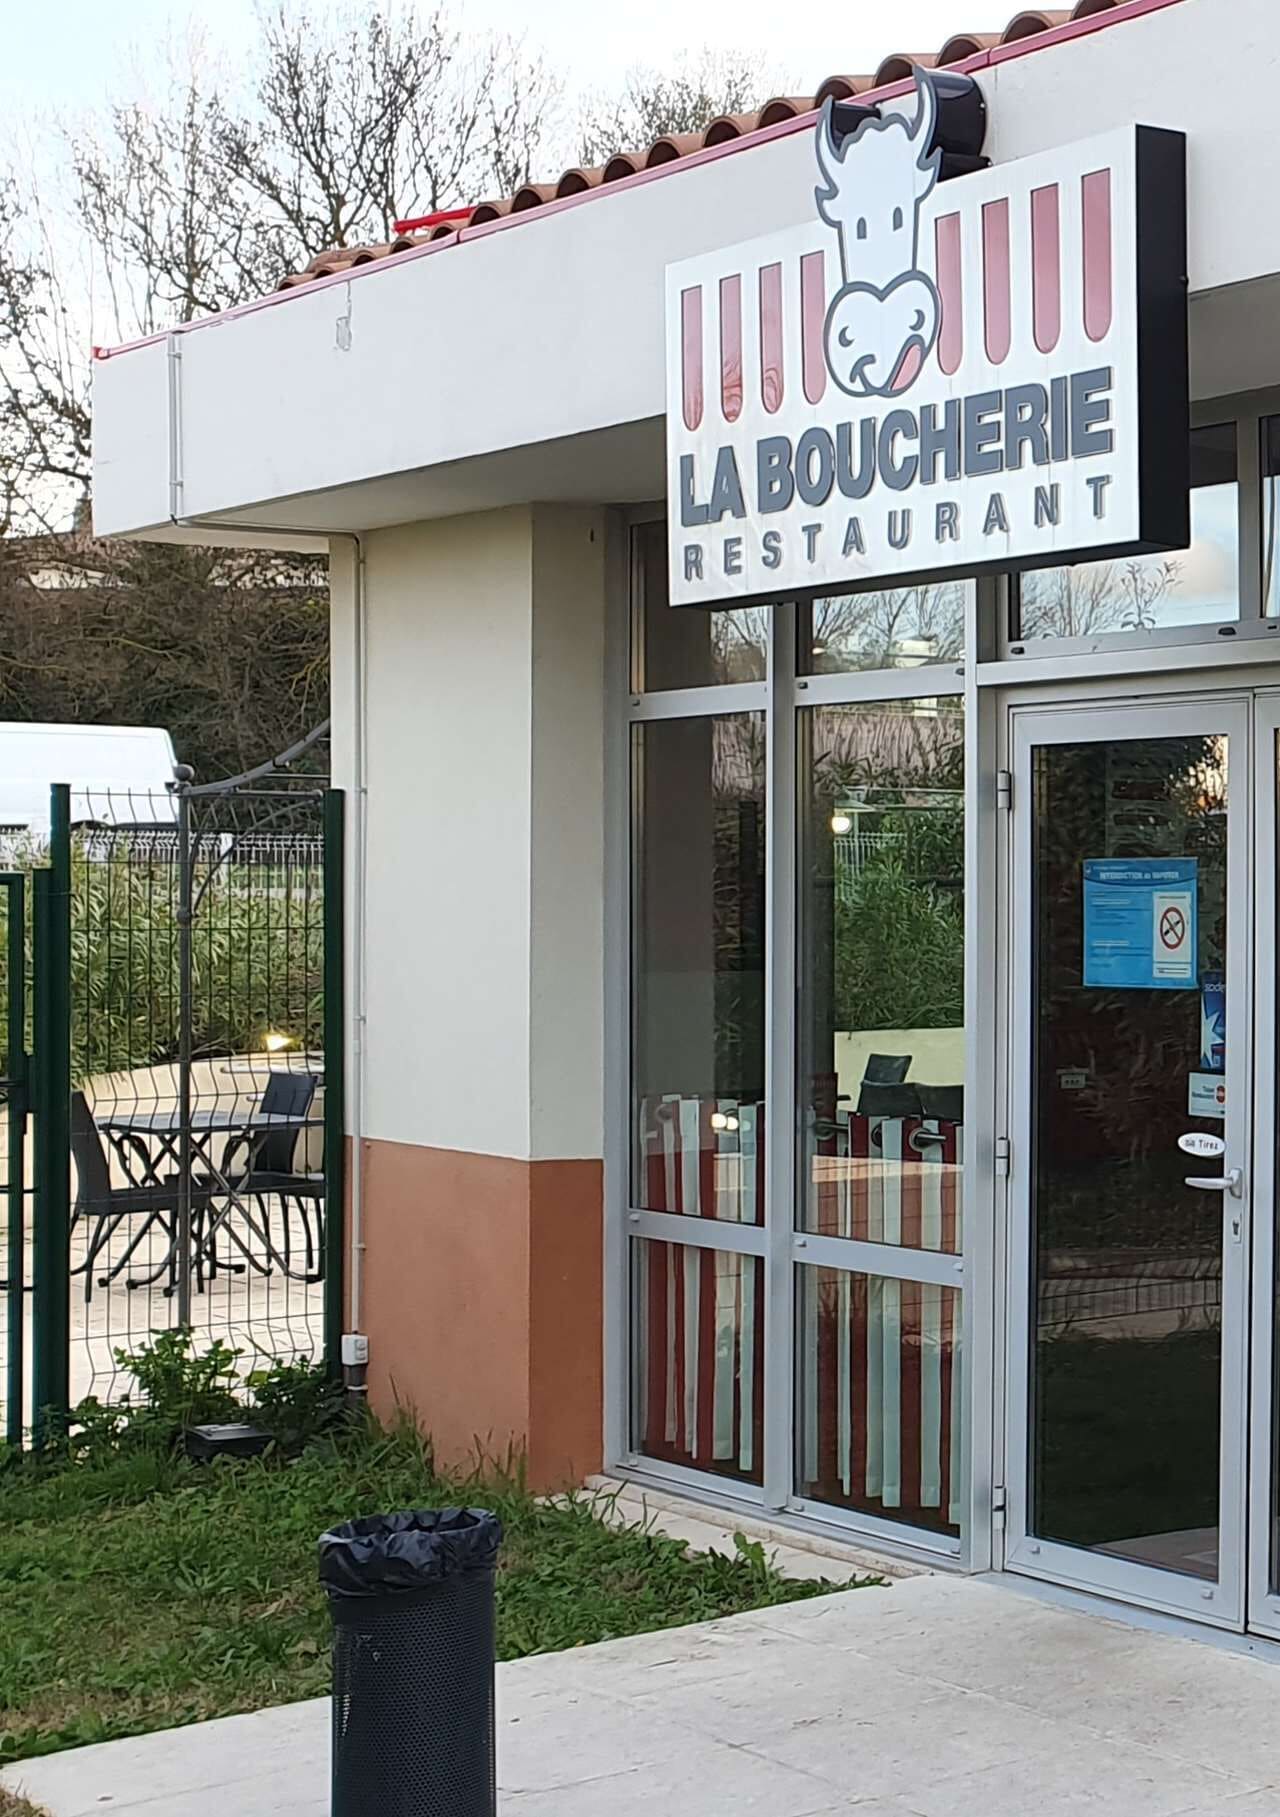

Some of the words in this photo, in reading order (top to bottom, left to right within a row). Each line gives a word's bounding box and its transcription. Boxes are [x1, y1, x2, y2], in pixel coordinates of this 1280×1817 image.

[679, 445, 747, 528] LA
[757, 366, 1115, 514] BOUCHERIE
[683, 474, 1111, 581] RESTAURANT
